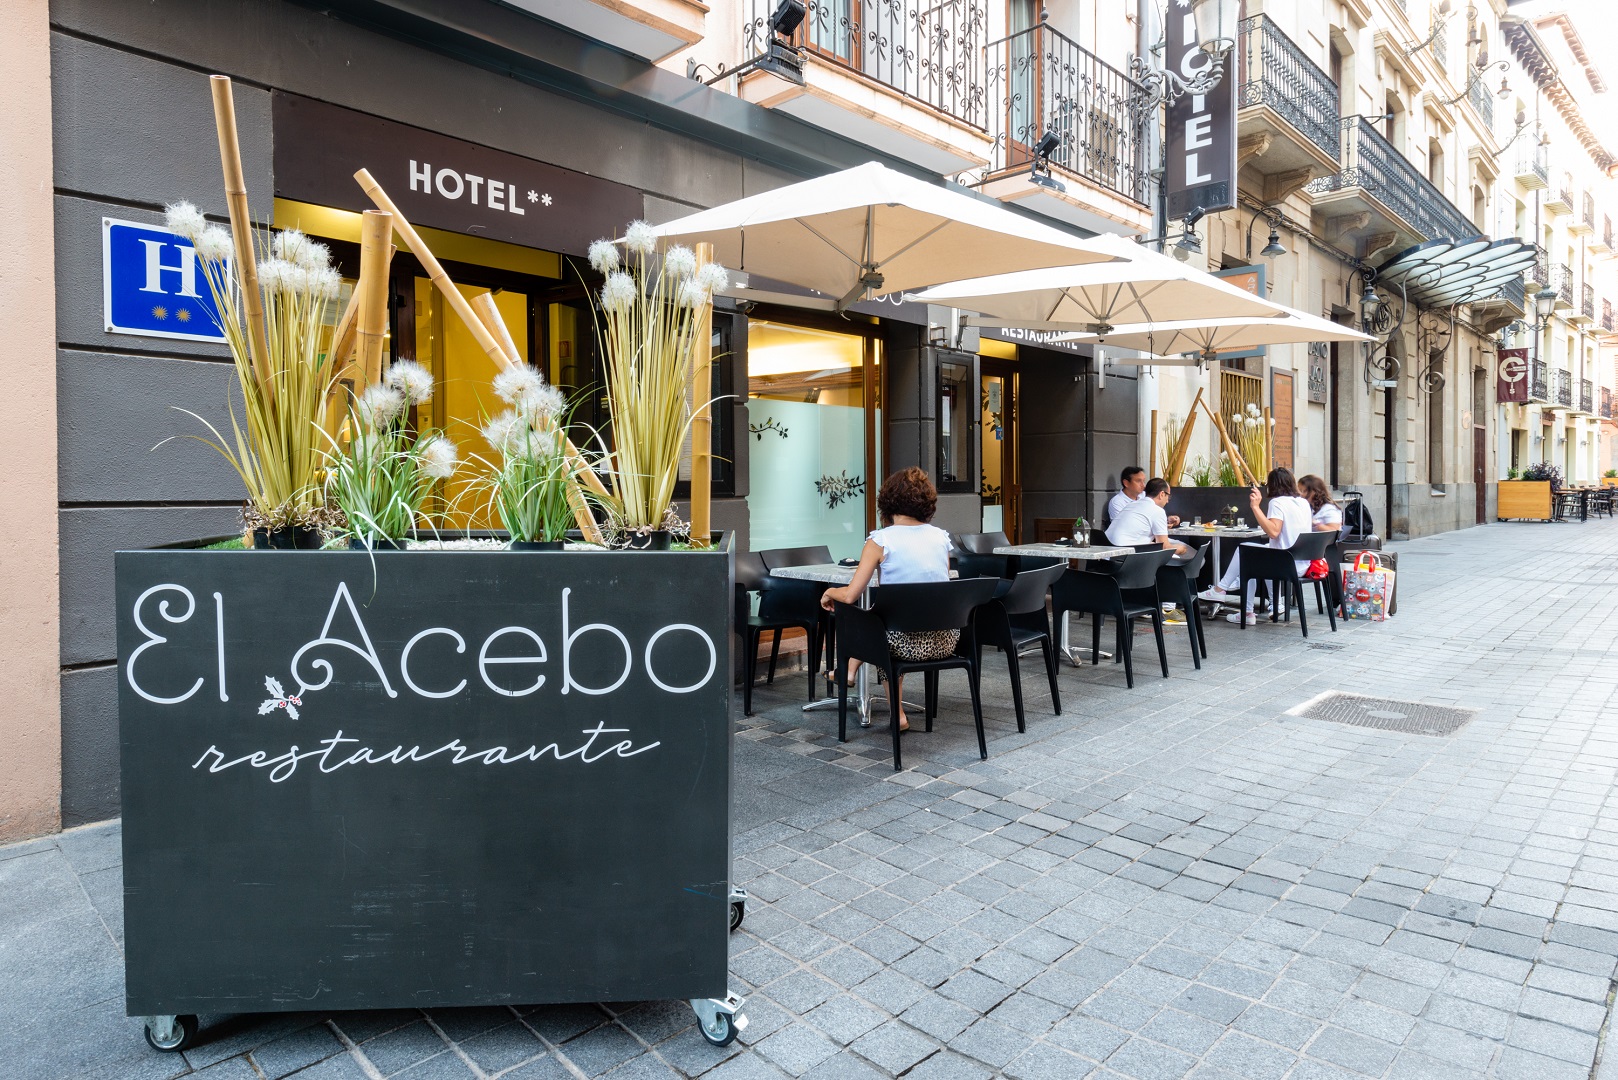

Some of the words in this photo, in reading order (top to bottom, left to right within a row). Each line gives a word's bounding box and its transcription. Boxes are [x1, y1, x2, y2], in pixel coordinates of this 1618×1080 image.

[138, 238, 203, 299] H
[127, 583, 230, 705] El
[291, 582, 717, 699] Acebo
[192, 720, 661, 783] restaurante
